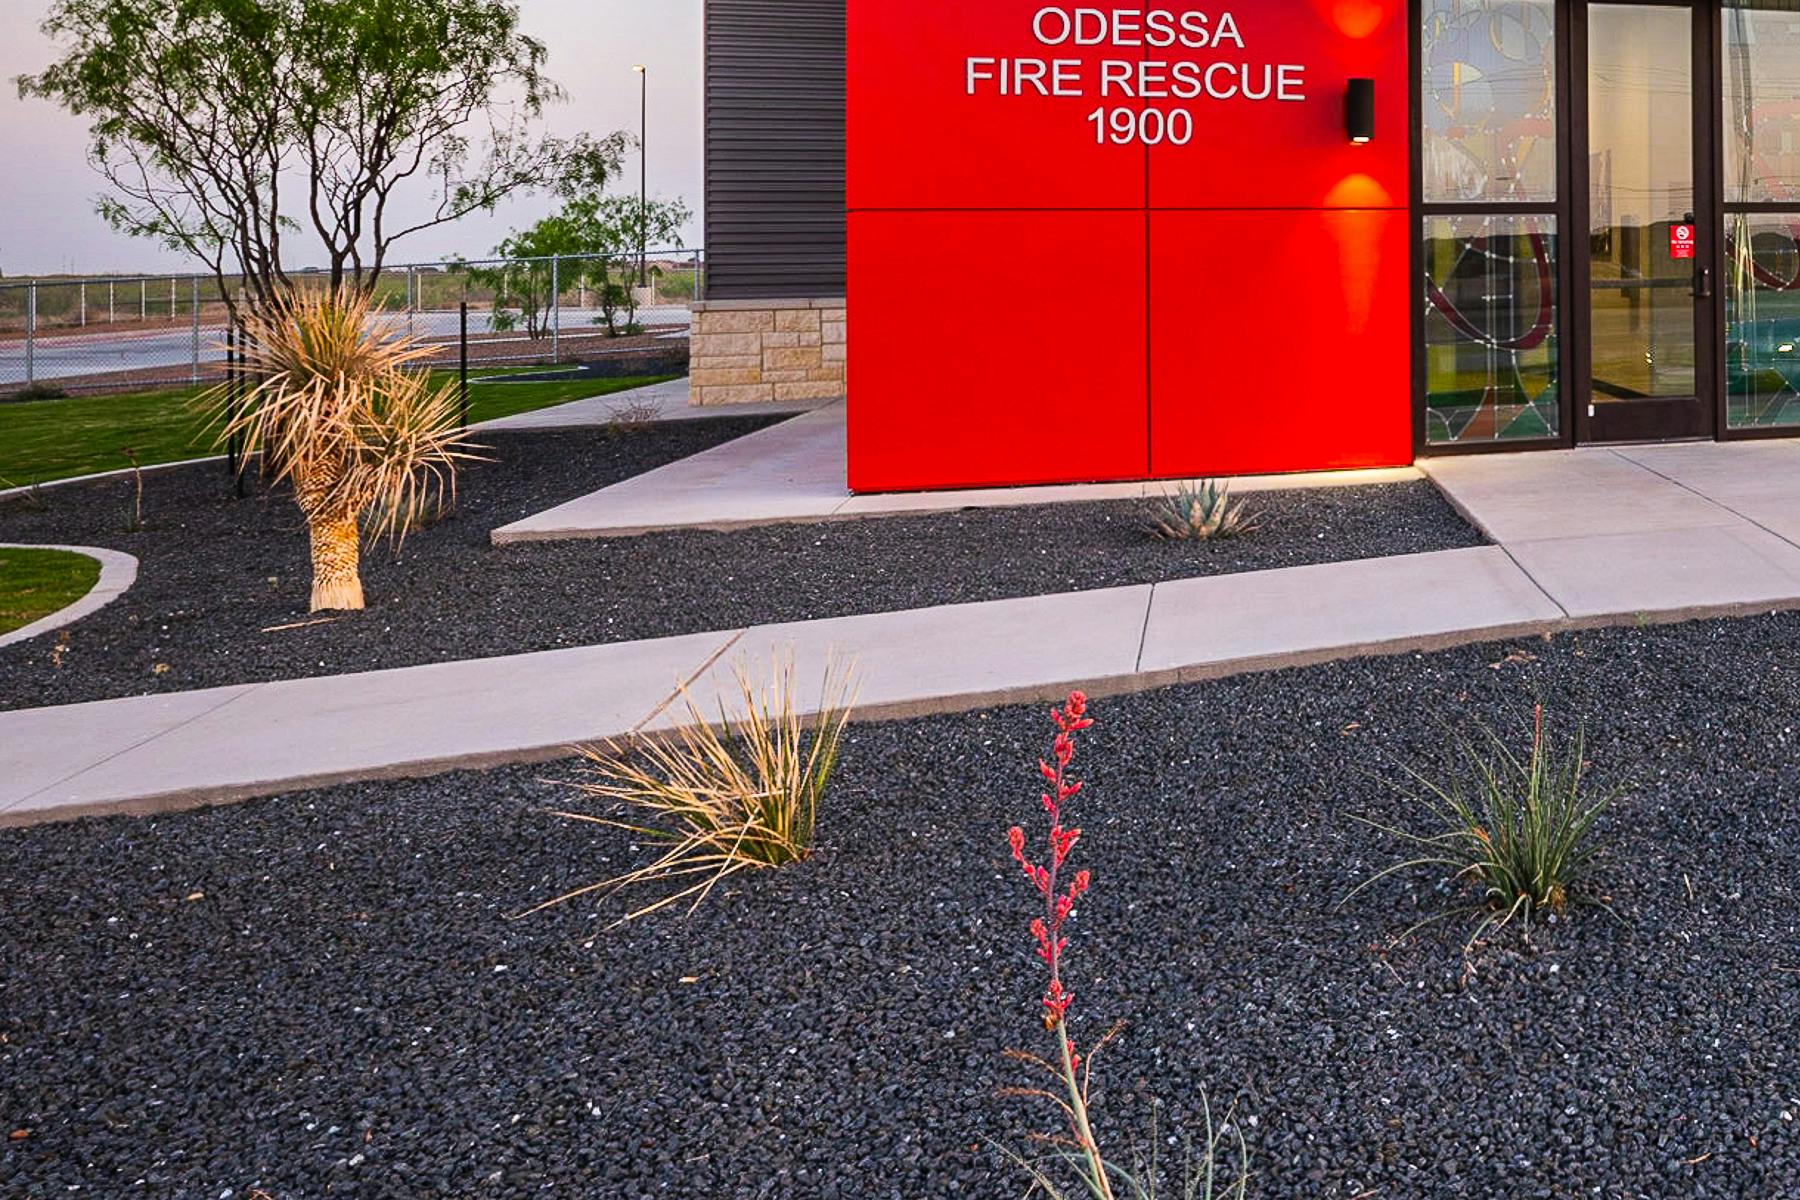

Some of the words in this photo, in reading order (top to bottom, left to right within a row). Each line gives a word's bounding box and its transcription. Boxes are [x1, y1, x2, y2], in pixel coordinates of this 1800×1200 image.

[1032, 6, 1245, 48] ODESSA
[966, 57, 1083, 96] FIRE
[1101, 60, 1305, 101] RESCUE
[1088, 107, 1193, 146] 1900
